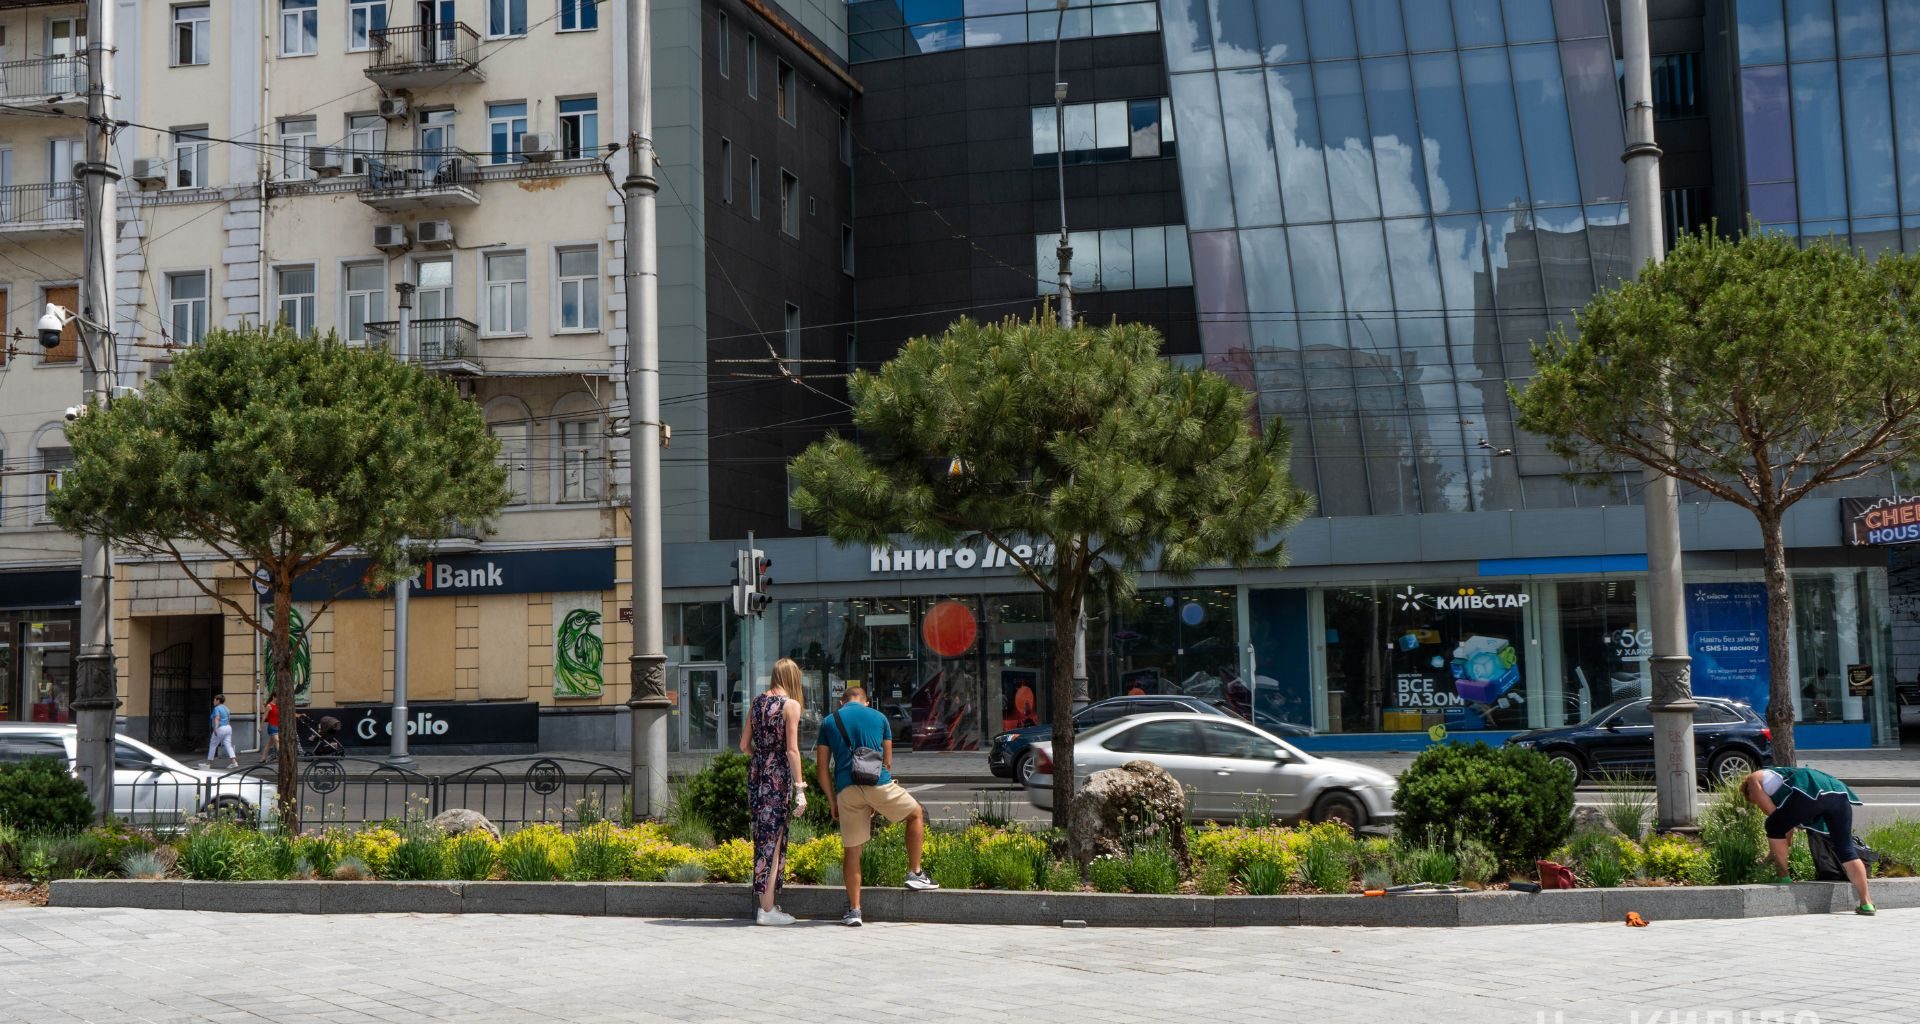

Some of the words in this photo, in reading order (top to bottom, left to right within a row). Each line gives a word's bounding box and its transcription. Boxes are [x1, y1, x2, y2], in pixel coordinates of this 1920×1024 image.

[1436, 588, 1530, 610] КИЇВСТАР
[1398, 678, 1434, 692] ВСЕ
[1398, 692, 1465, 706] РАЗОМ
